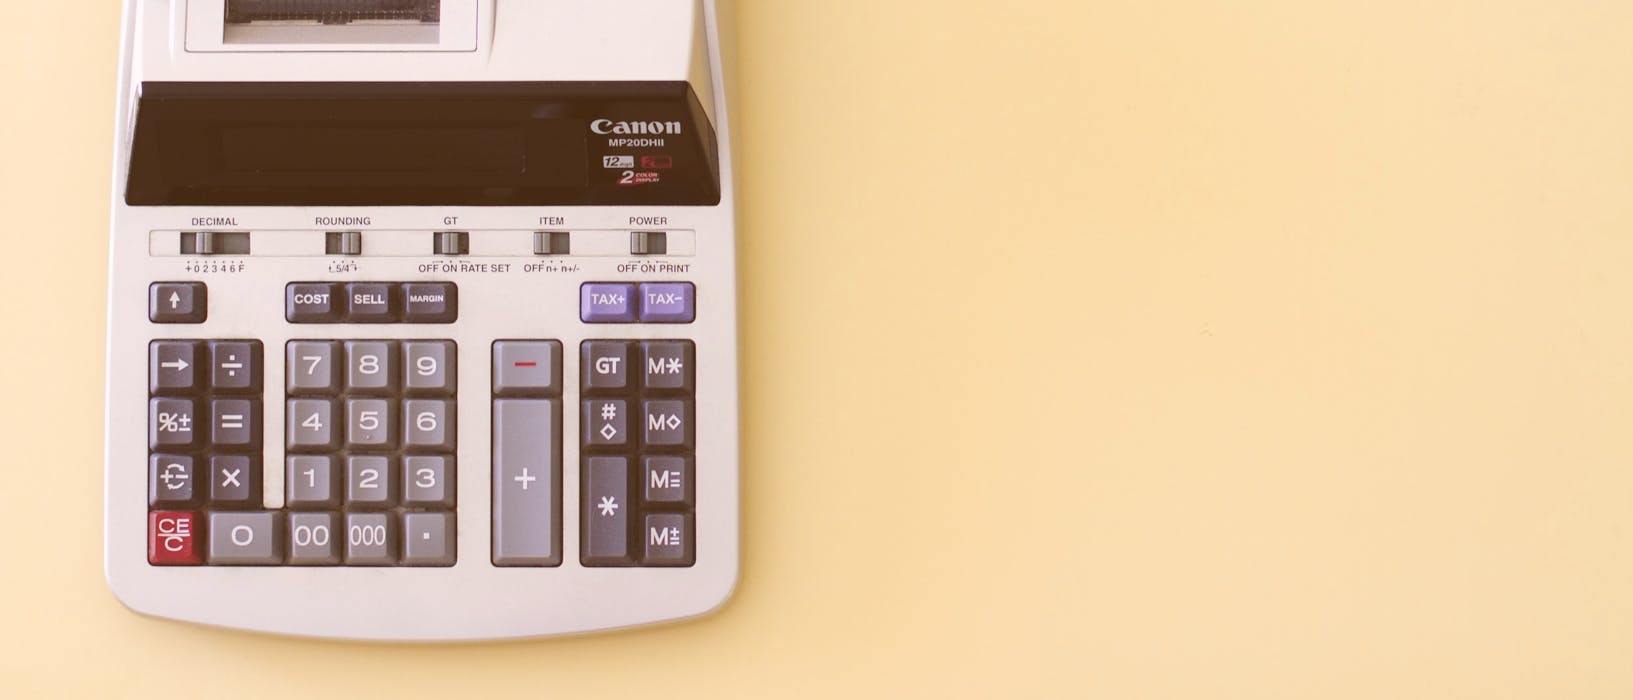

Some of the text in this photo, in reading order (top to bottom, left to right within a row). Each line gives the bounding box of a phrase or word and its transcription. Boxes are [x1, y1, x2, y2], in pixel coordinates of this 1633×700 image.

[590, 119, 681, 134] Canon
[605, 157, 619, 166] 12
[620, 171, 634, 184] 2
[192, 218, 238, 226] DECIMAL
[315, 217, 371, 225] ROUNDING
[444, 217, 458, 225] GT
[540, 217, 564, 225] ITEM
[629, 216, 667, 225] POWER
[419, 264, 511, 273] OFF ON RATE SET
[524, 264, 544, 273] OFF
[617, 264, 690, 273] OFF ON PRINT
[295, 294, 328, 304] COST
[354, 294, 384, 304] SELL
[591, 294, 625, 305] TAX+
[303, 356, 321, 374] 7
[359, 355, 378, 374] 8
[416, 357, 437, 376] 9
[596, 357, 620, 374] GT
[302, 412, 322, 431] 4
[359, 412, 378, 430] 5
[416, 412, 436, 431] 6
[304, 470, 314, 487] 1
[359, 470, 378, 488] 2
[416, 469, 436, 488] 3
[158, 518, 190, 534] CE
[232, 526, 254, 546] 0
[294, 526, 328, 544] 00
[350, 525, 386, 546] 000
[164, 536, 184, 552] C
